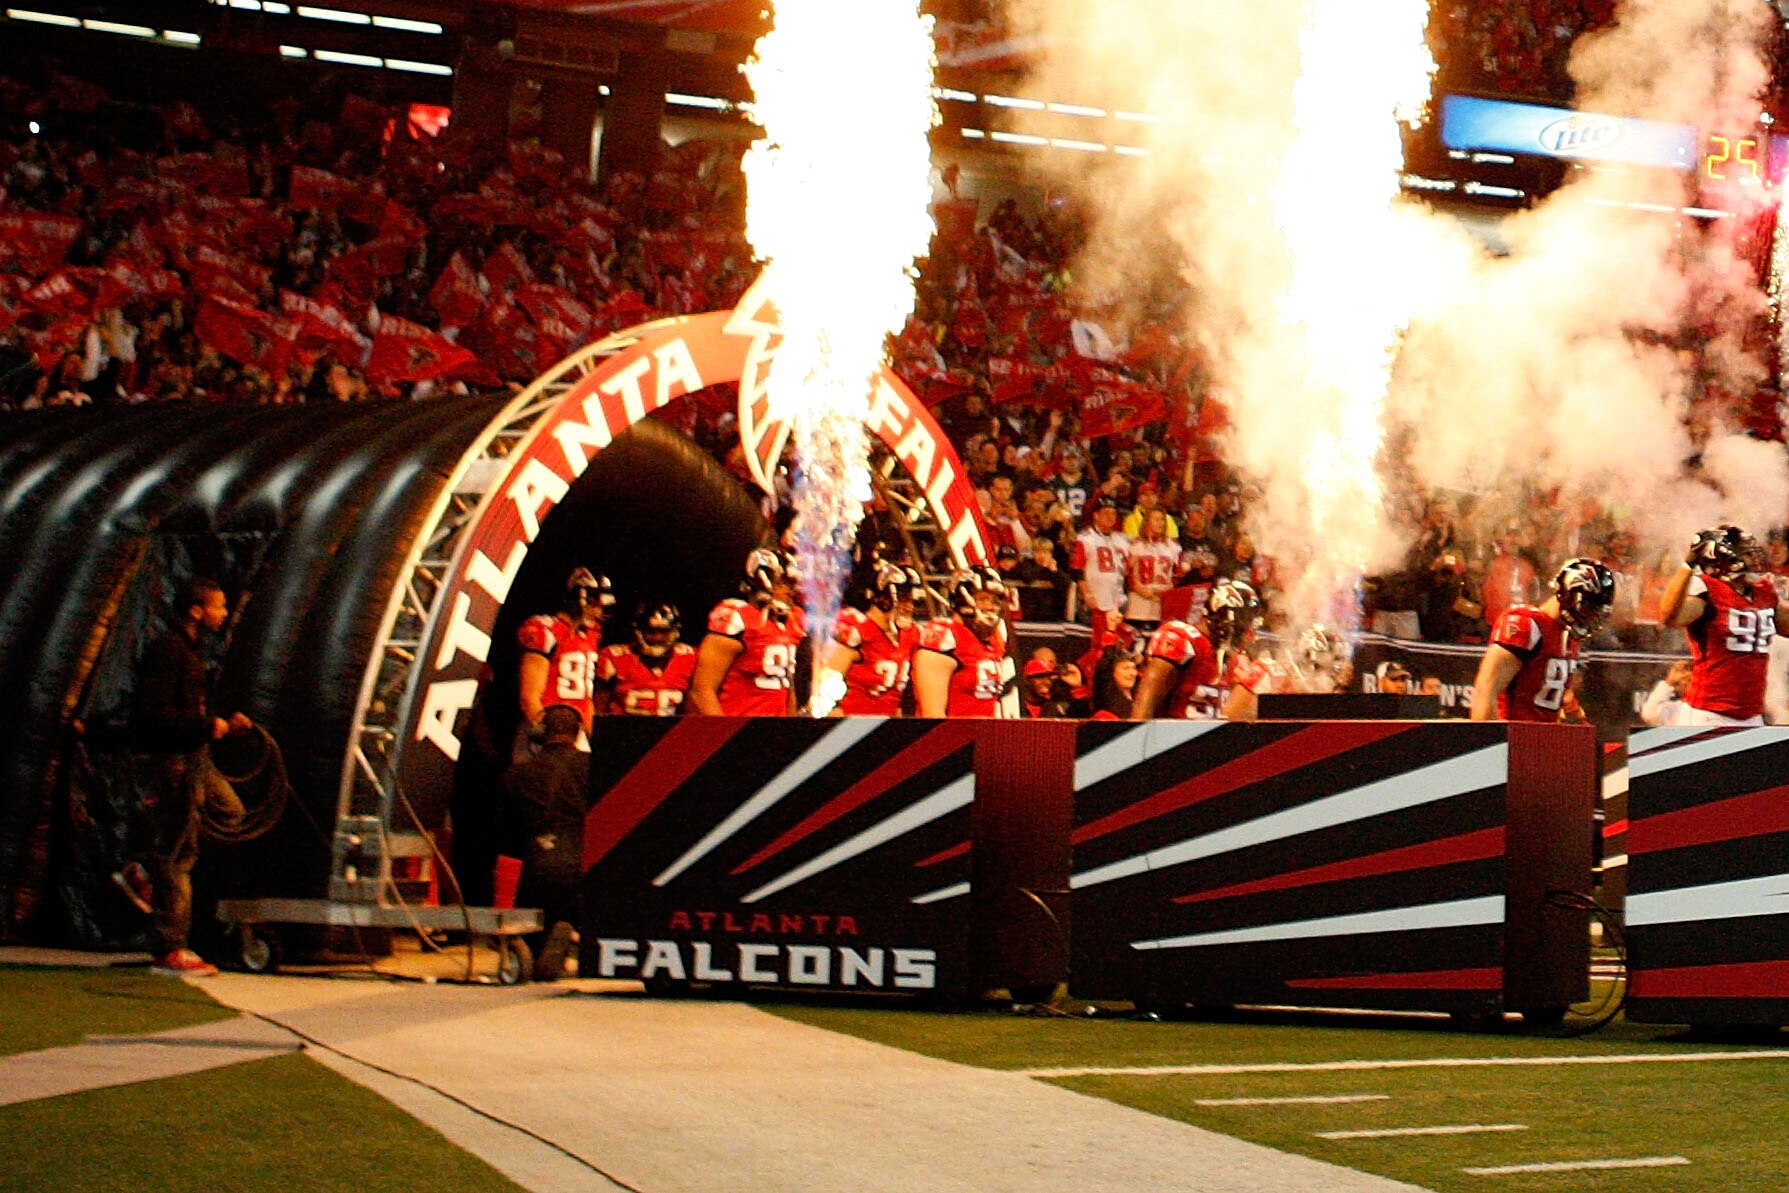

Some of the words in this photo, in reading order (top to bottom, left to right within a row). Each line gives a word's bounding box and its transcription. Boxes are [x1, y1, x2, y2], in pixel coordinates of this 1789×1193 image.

[1707, 135, 1757, 180] 25
[866, 375, 987, 570] FALC
[416, 338, 704, 761] ATLANTA
[1533, 657, 1577, 711] 8
[670, 911, 859, 936] ATLANTA
[598, 937, 937, 990] FALCONS
